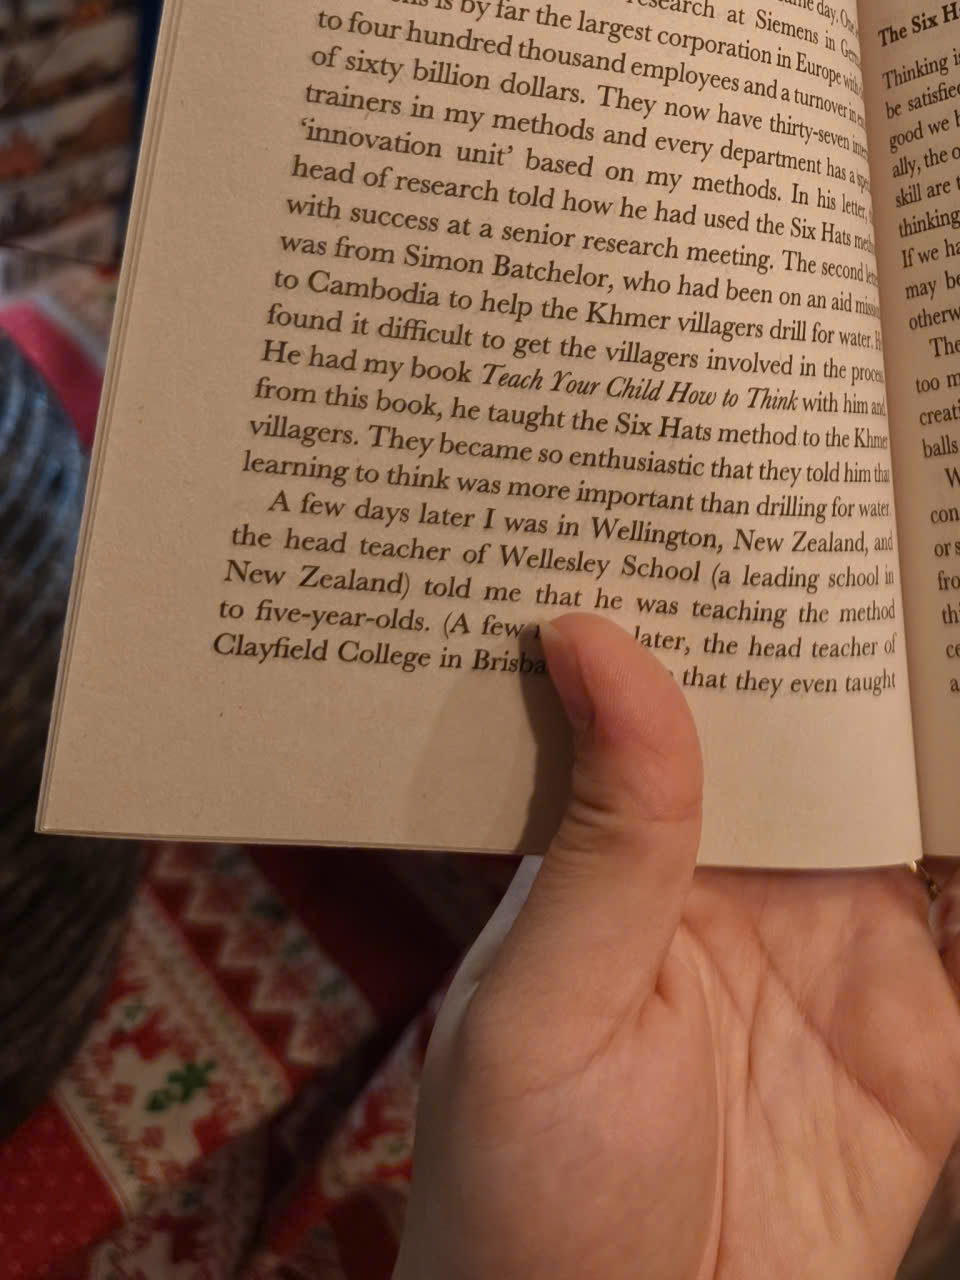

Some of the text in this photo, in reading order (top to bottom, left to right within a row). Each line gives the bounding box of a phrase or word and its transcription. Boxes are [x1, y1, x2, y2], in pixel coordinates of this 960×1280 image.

[878, 25, 907, 47] The
[912, 12, 939, 34] Six
[882, 56, 949, 90] Thinking
[526, 147, 593, 178] based
[605, 166, 633, 183] on
[646, 171, 683, 194] my
[692, 174, 781, 201] methods.
[791, 183, 809, 205] In
[817, 187, 836, 210] his
[902, 247, 915, 269] If
[918, 248, 939, 264] we
[274, 270, 299, 290] to
[308, 270, 441, 307] Cambodia
[450, 290, 473, 310] to
[480, 289, 533, 323] help
[542, 297, 579, 321] the
[585, 301, 671, 330] Khmer
[678, 311, 763, 343] villagers
[770, 318, 807, 342] drill
[812, 322, 835, 344] for
[260, 339, 868, 414] He had my book Teach Your Child How to Think with him
[916, 377, 940, 394] too
[224, 559, 895, 629] New Zealand) told me that he was teaching the method
[213, 632, 461, 673] Clayfield College in
[682, 665, 895, 699] that they even taught
